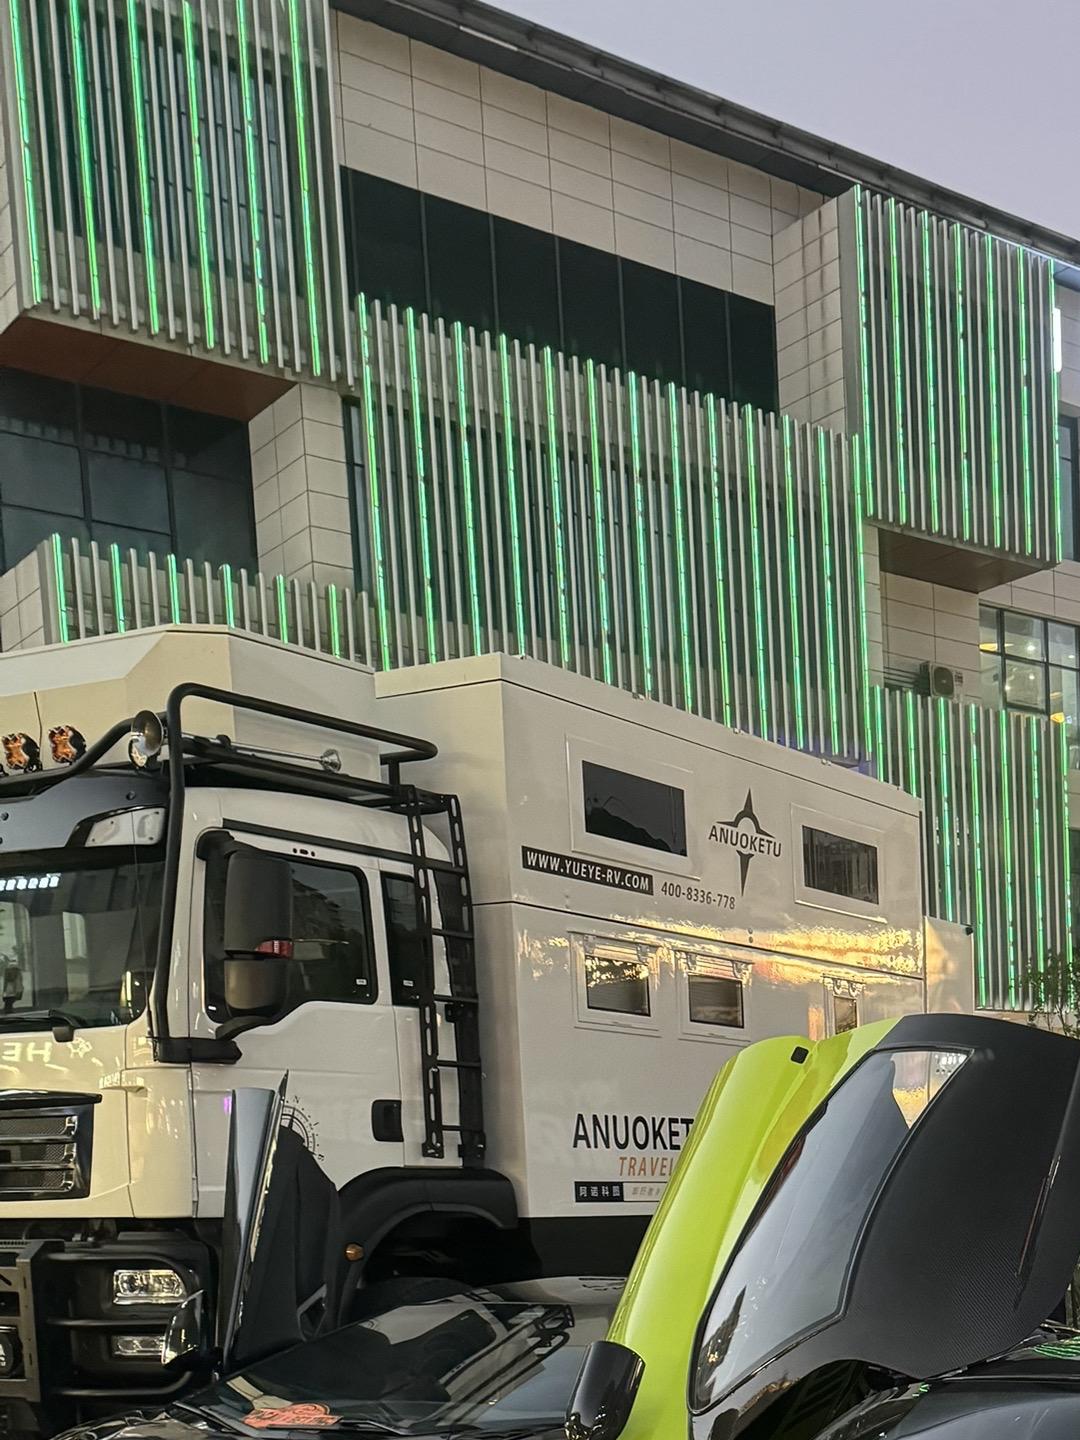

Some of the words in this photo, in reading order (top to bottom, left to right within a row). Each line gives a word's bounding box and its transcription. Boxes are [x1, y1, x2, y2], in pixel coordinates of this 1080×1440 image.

[708, 825, 782, 858] ANUOKETU
[526, 850, 650, 891] WWW.YUEYE-RV.COM
[661, 881, 736, 910] 400-8336-778
